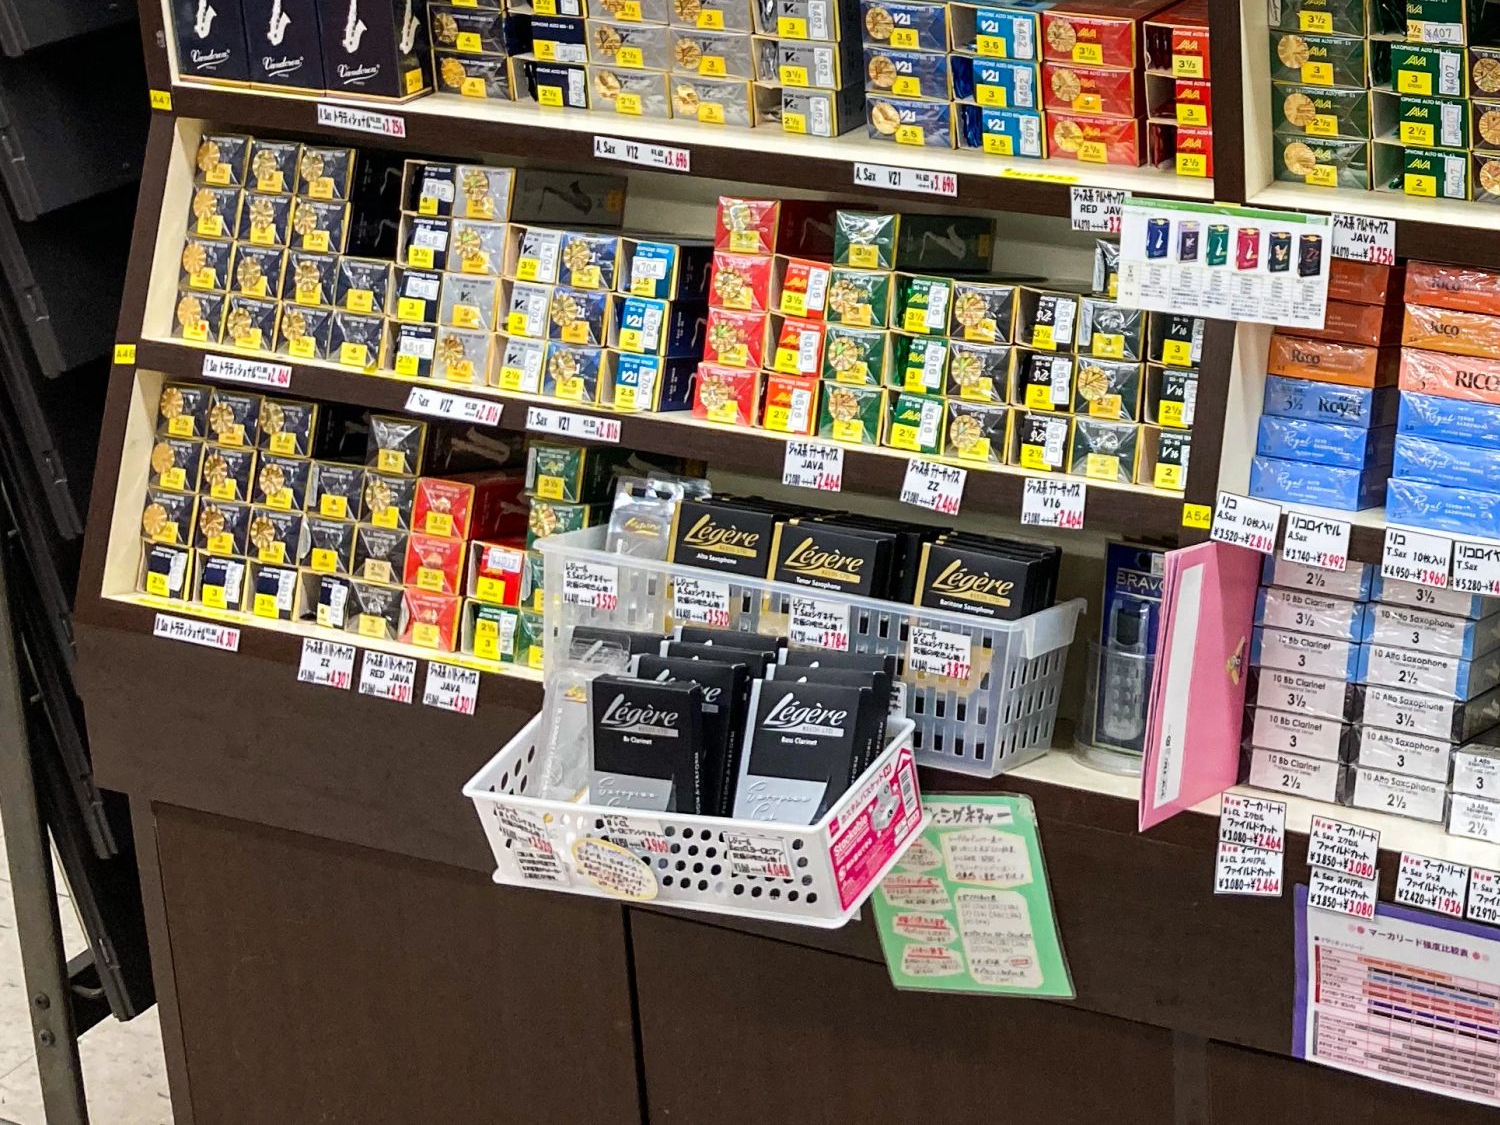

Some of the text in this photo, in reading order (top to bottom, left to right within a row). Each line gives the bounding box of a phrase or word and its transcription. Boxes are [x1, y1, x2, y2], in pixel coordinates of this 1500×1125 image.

[1350, 233, 1376, 245] JAVA
[1455, 369, 1500, 392] RICO
[1222, 496, 1237, 510] リコ
[1185, 508, 1210, 523] A54
[1292, 515, 1341, 537] リコロイヤル
[684, 513, 759, 548] Légère
[785, 537, 864, 573] Légère
[933, 559, 1015, 595] Légère
[1403, 654, 1447, 668] Saxophone
[1296, 679, 1326, 690] Clarinet
[601, 693, 679, 726] Légère
[763, 692, 848, 726] Légère
